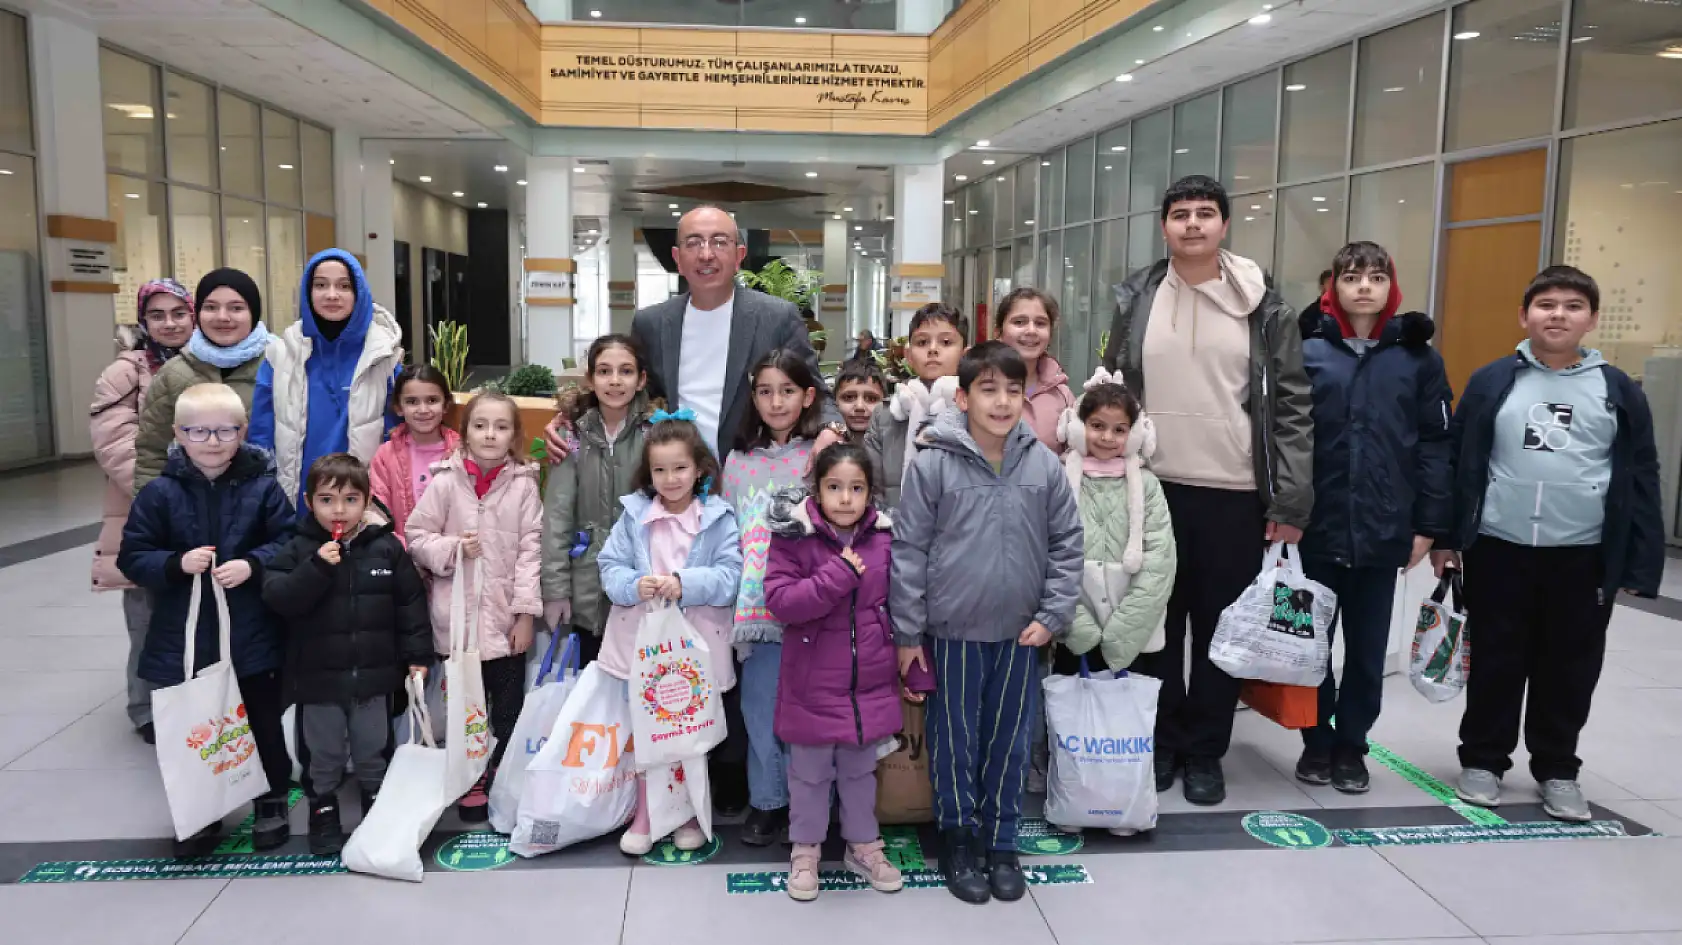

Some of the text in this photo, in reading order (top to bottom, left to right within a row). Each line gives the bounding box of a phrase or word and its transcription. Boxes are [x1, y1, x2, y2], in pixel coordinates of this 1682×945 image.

[576, 55, 616, 66] TEMEL
[707, 58, 734, 70] TÜM
[735, 61, 852, 74] ÇALIŞANLARIMIZLA
[550, 67, 618, 80] SAMİMİYET
[618, 71, 636, 81] VE
[638, 71, 699, 82] GAYRETLE
[704, 73, 820, 86] HEMŞEHRİLERİMİZE
[821, 74, 865, 87] HİZMET
